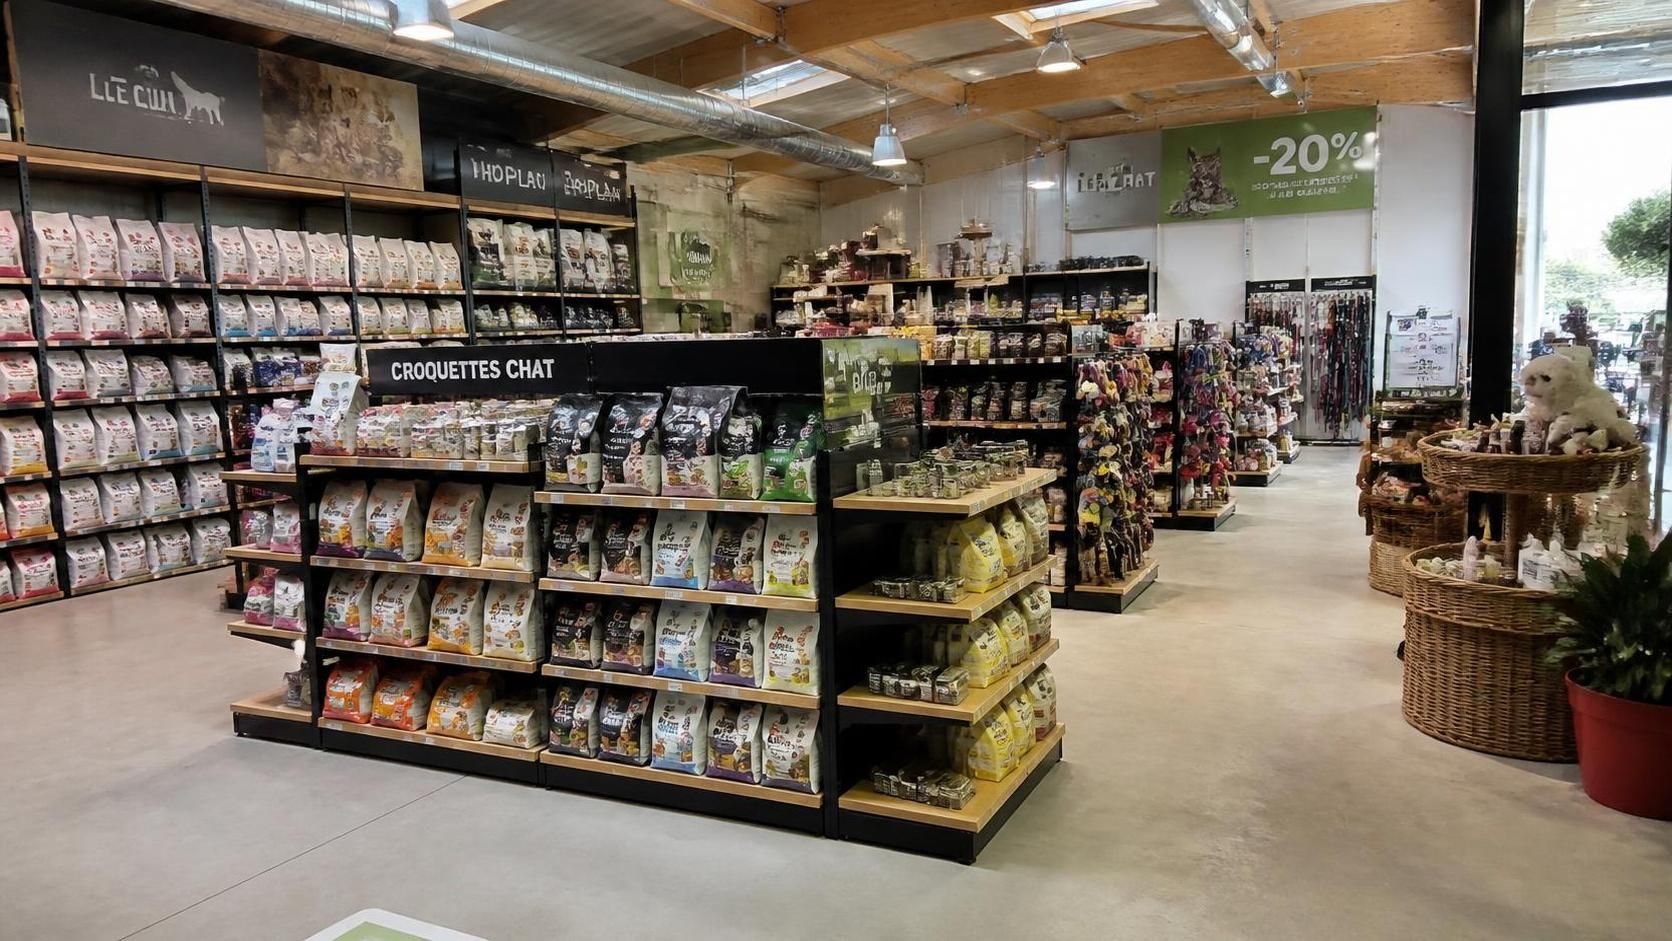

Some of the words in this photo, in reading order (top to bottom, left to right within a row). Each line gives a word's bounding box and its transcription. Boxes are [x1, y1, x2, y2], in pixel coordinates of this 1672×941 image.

[1253, 131, 1362, 175] -20%
[391, 360, 501, 382] CROQUETTES
[505, 359, 555, 379] CHAT
